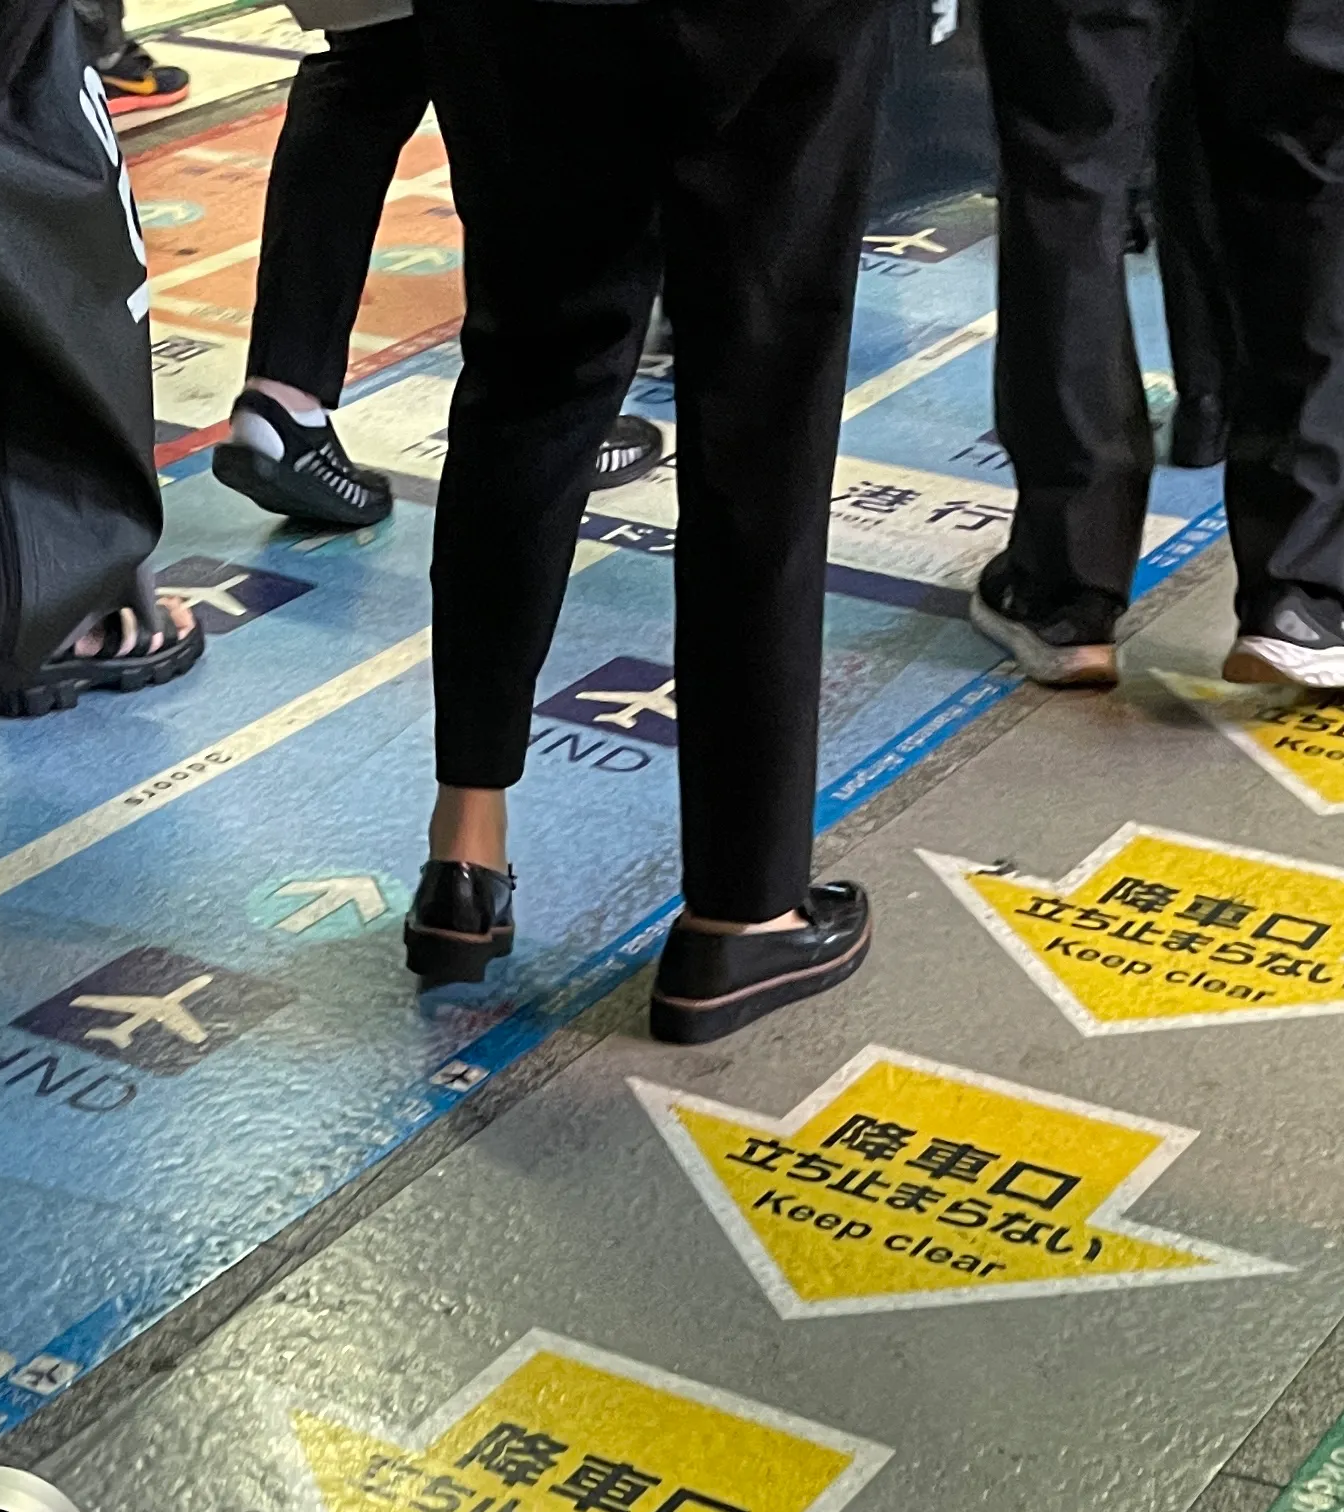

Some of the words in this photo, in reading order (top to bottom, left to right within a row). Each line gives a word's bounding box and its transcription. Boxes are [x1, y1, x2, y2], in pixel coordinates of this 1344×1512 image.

[1097, 876, 1333, 950] 降車口
[1044, 936, 1154, 977] Keep
[1165, 968, 1278, 1003] clear
[724, 1136, 1104, 1262] 立ち止まらない
[820, 1113, 1083, 1212] 降車口
[751, 1188, 873, 1241] Keep
[883, 1231, 1008, 1279] clear
